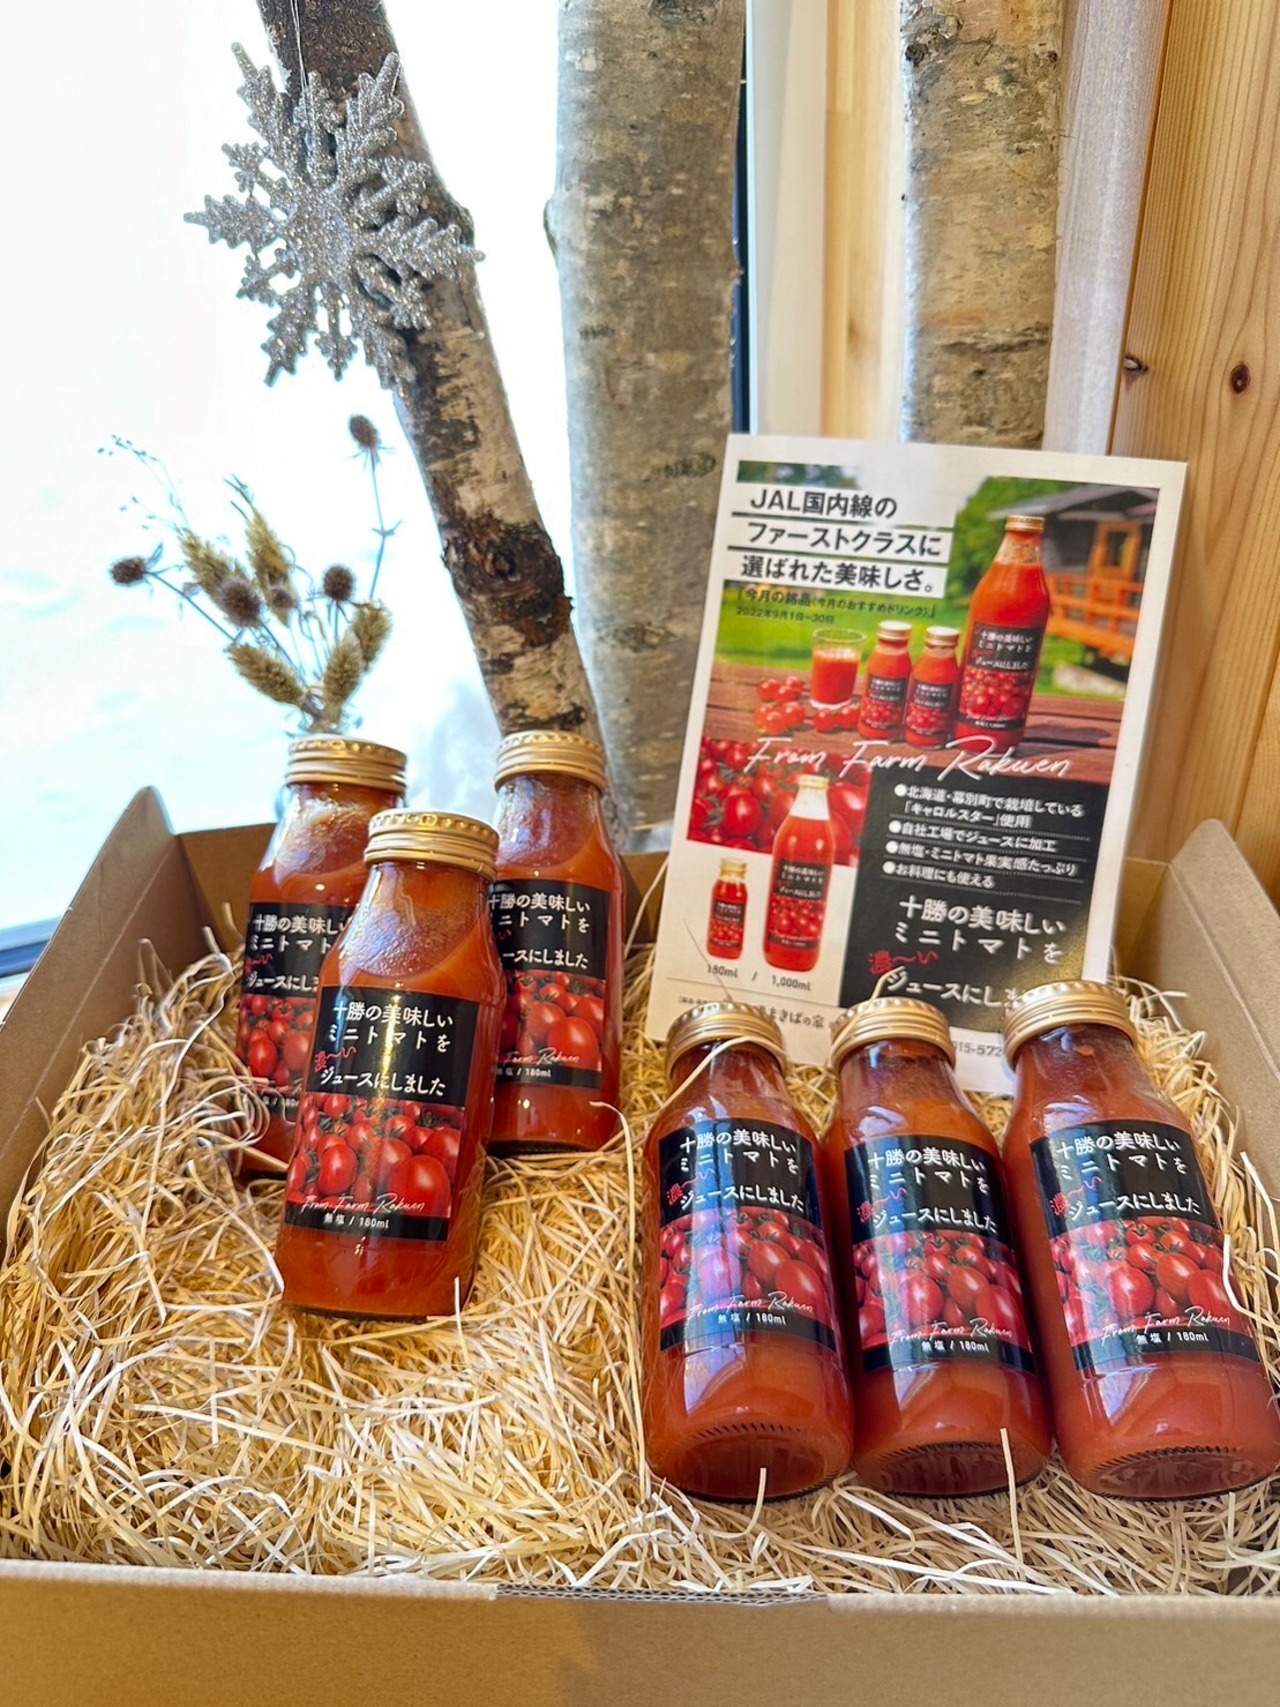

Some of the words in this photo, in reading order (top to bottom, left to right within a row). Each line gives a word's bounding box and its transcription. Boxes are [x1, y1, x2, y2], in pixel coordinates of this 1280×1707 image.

[750, 488, 898, 519] JAL国内線の
[747, 522, 941, 557] ファーストクラスに
[740, 554, 934, 593] 選ばれた美味しさ。
[743, 737, 827, 774] From
[839, 739, 928, 778] Farm
[937, 735, 1071, 781] Rakuen
[902, 821, 1057, 853] 自社工場でジュースに加工
[895, 863, 996, 889] お料理にも使える
[899, 895, 1067, 934] 十勝の美味しい
[895, 921, 1063, 963] ミニトマトを
[772, 975, 811, 991] 1,000ml
[334, 1001, 453, 1027] 十勝の美味しい
[328, 1024, 451, 1052] ミニトマトを
[320, 1066, 446, 1096] ジュースにしました
[680, 1128, 796, 1153] 十勝の美味しい
[1056, 1130, 1182, 1160] 十勝の美味しい
[680, 1148, 798, 1174] ミニトマトを
[868, 1147, 986, 1172] 十勝の美味しい
[1059, 1153, 1188, 1181] ミニトマトを
[869, 1167, 989, 1194] ミニトマトを
[333, 1194, 370, 1212] Farm
[375, 1192, 425, 1212] Rakuen
[680, 1185, 804, 1212] ジュースにしました
[1068, 1191, 1201, 1221] ジュースにしました
[359, 1216, 389, 1229] 180ml
[872, 1206, 998, 1234] ジュースにしました
[756, 1312, 786, 1326] 180ml
[959, 1340, 989, 1353] 180ml
[1176, 1331, 1209, 1342] 180ml
